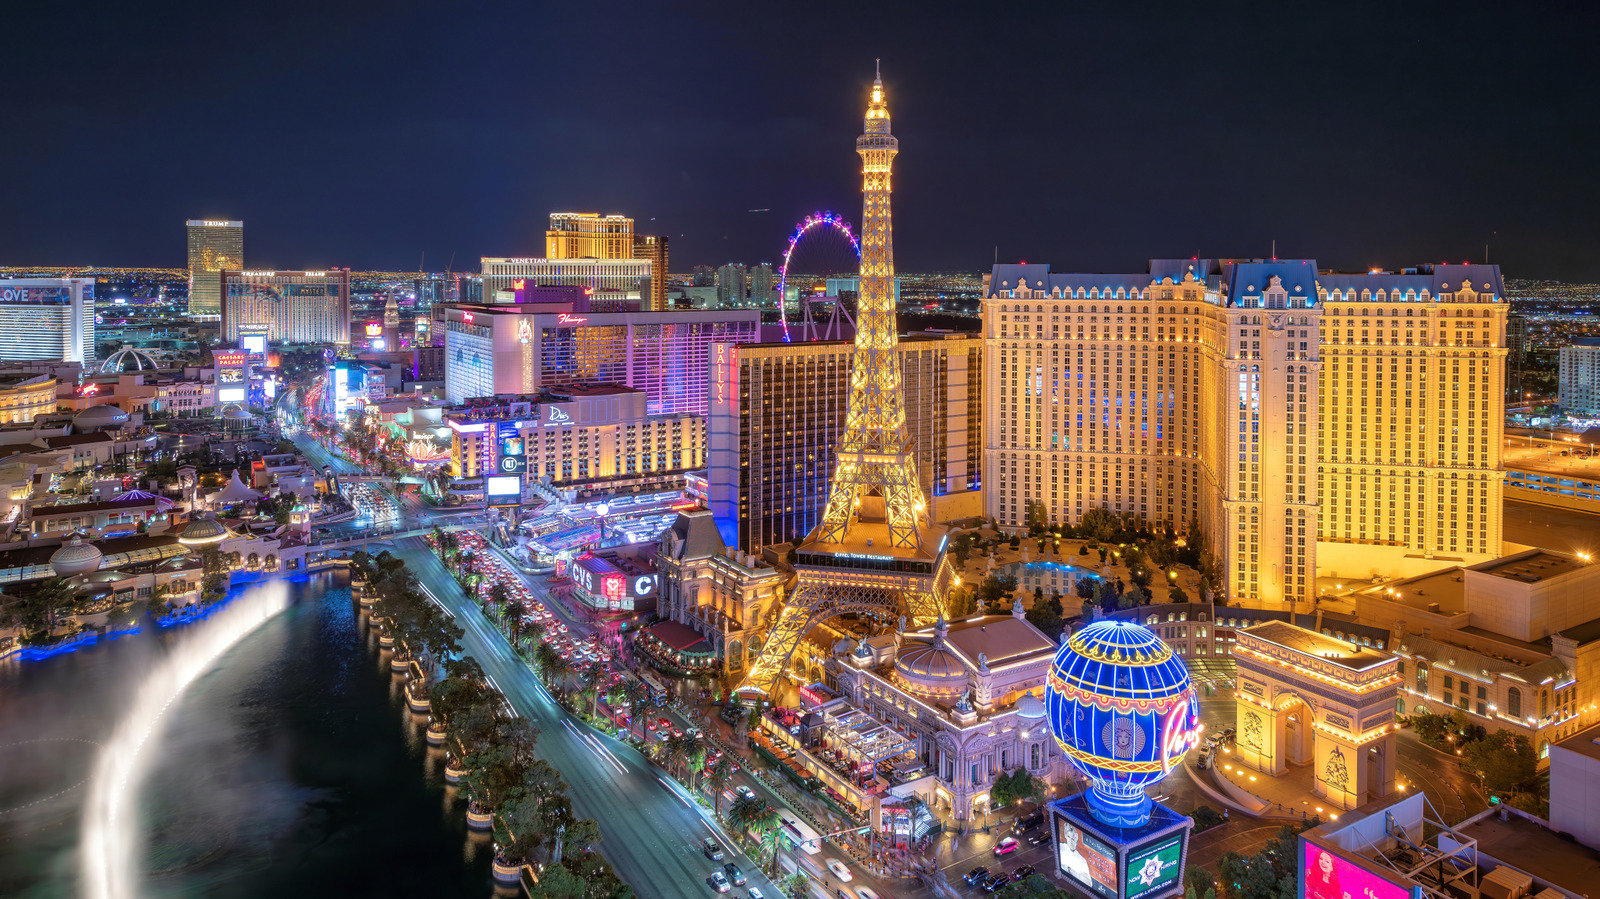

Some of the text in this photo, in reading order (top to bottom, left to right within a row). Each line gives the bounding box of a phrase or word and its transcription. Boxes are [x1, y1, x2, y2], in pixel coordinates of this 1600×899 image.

[558, 313, 587, 324] Flamingo
[572, 563, 593, 592] CVS
[810, 693, 822, 705] PARK
[1163, 700, 1204, 774] Paris
[1129, 859, 1177, 884] NOW HIRING
